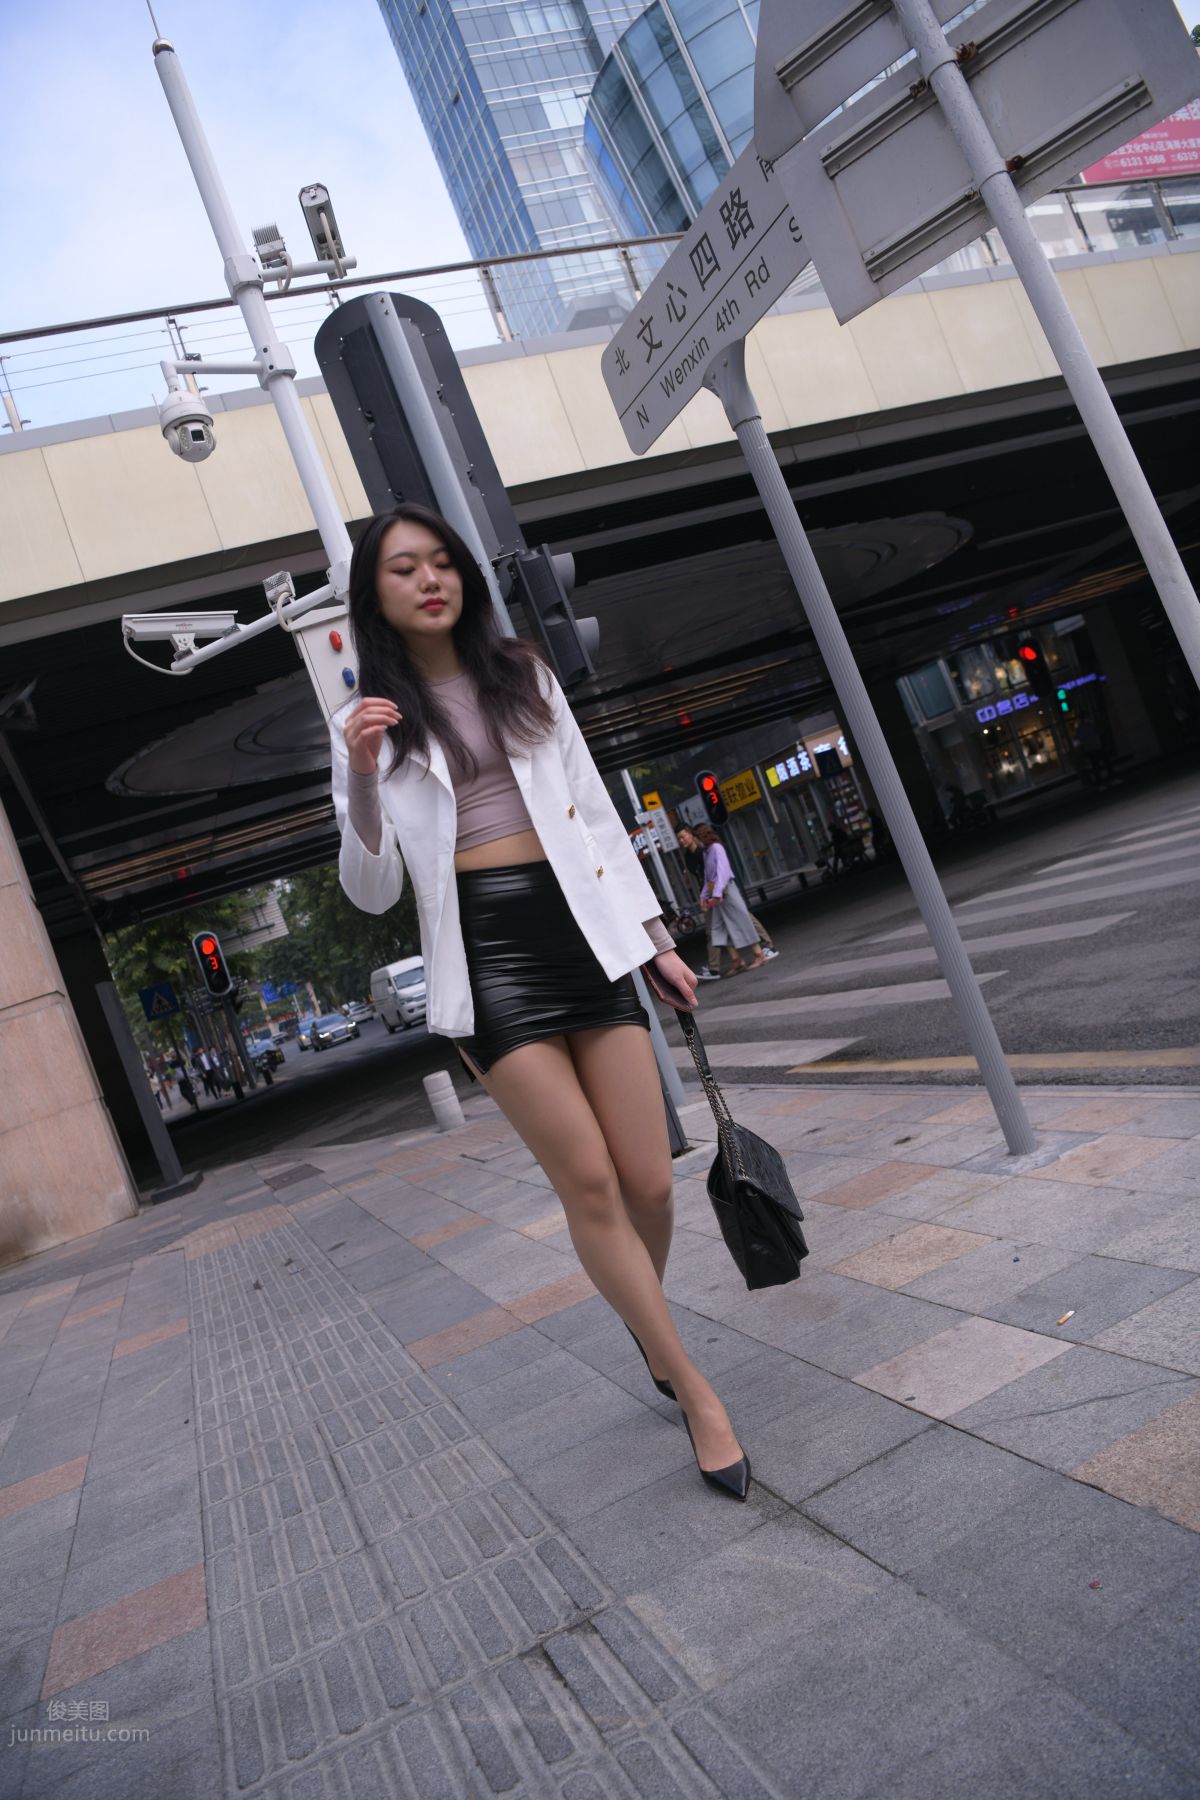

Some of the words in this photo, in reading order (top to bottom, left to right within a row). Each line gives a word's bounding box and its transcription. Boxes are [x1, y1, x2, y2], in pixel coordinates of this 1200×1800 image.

[615, 347, 630, 376] 北
[637, 187, 755, 364] 文心四路
[636, 404, 650, 430] N
[659, 336, 710, 398] Wenxin
[716, 298, 741, 333] 4th
[744, 256, 771, 298] Rd
[788, 216, 803, 243] S
[210, 956, 219, 970] 3
